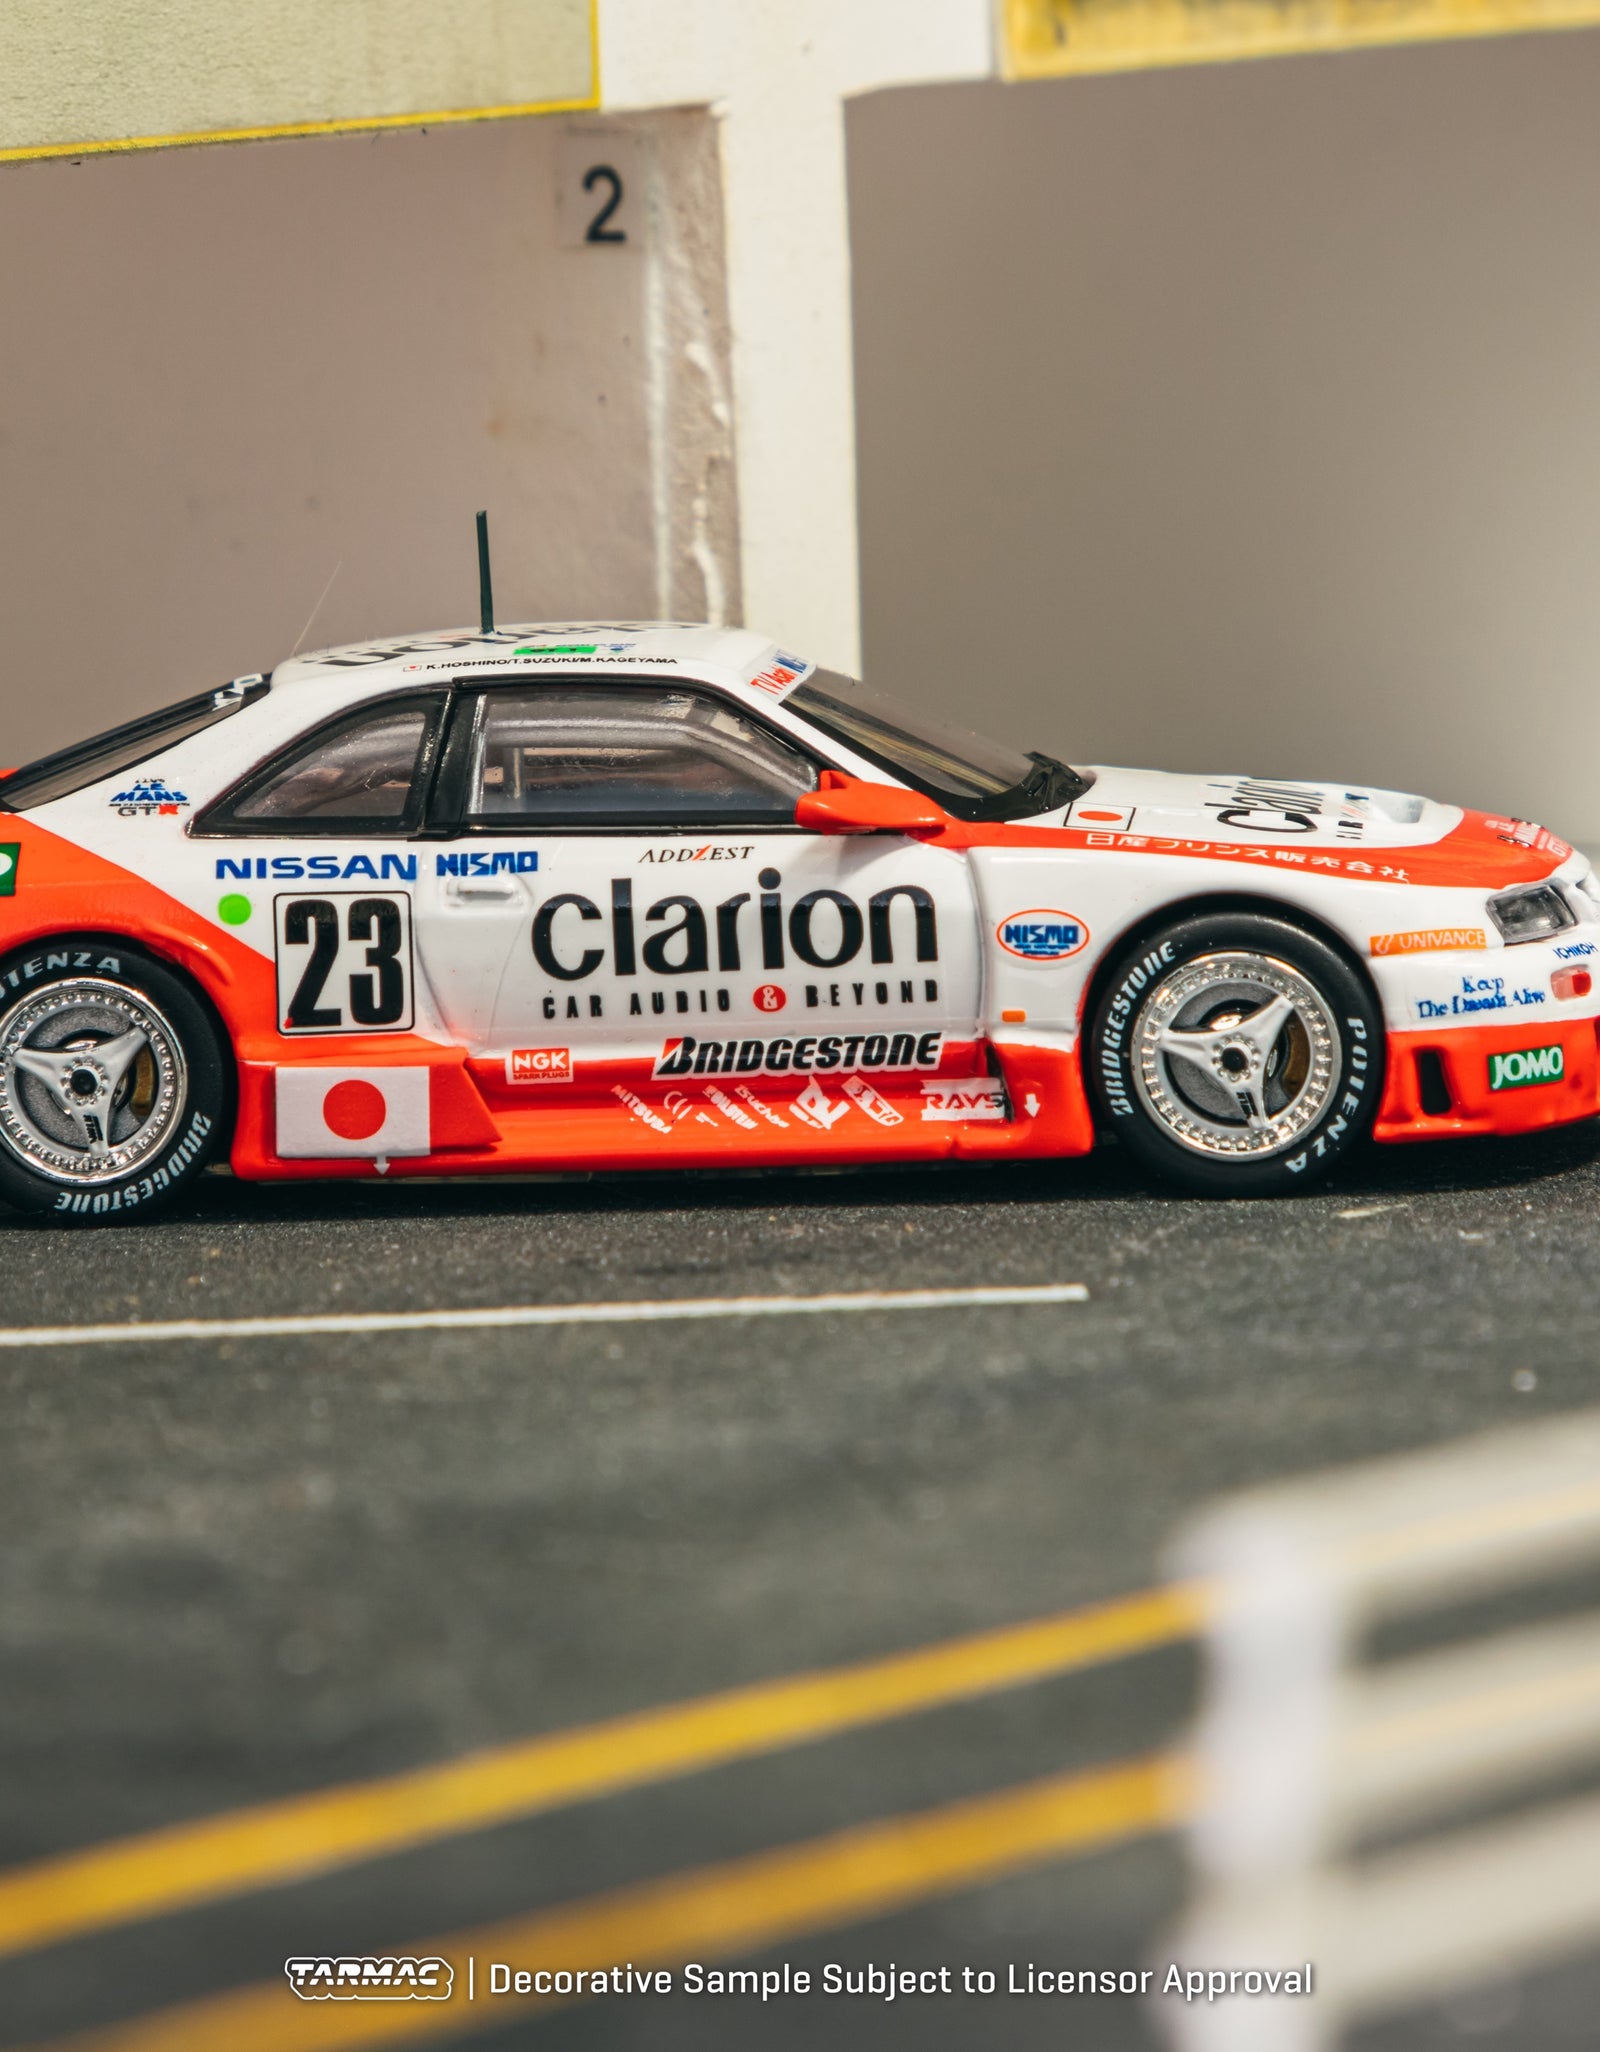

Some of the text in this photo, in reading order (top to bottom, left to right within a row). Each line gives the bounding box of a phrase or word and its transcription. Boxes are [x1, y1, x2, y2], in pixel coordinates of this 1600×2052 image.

[583, 165, 626, 242] 2
[110, 791, 188, 802] MANS
[436, 851, 538, 877] NISMO
[638, 844, 755, 863] ADDZEST
[1086, 832, 1411, 884] 日産プリンス販売会社
[215, 854, 417, 880] NISSAN
[531, 867, 939, 981] clarion
[1005, 925, 1079, 944] NISMO
[1399, 930, 1486, 949] UNIVANCE
[1552, 942, 1599, 959] ICHIKOH
[284, 898, 404, 1028] 23
[543, 996, 603, 1020] CAR
[629, 988, 731, 1017] AUDIO
[805, 979, 939, 1009] BEYOND
[513, 1050, 567, 1072] NGK
[656, 1031, 942, 1078] BRIDGESTONE
[1491, 1046, 1564, 1090] JOMO
